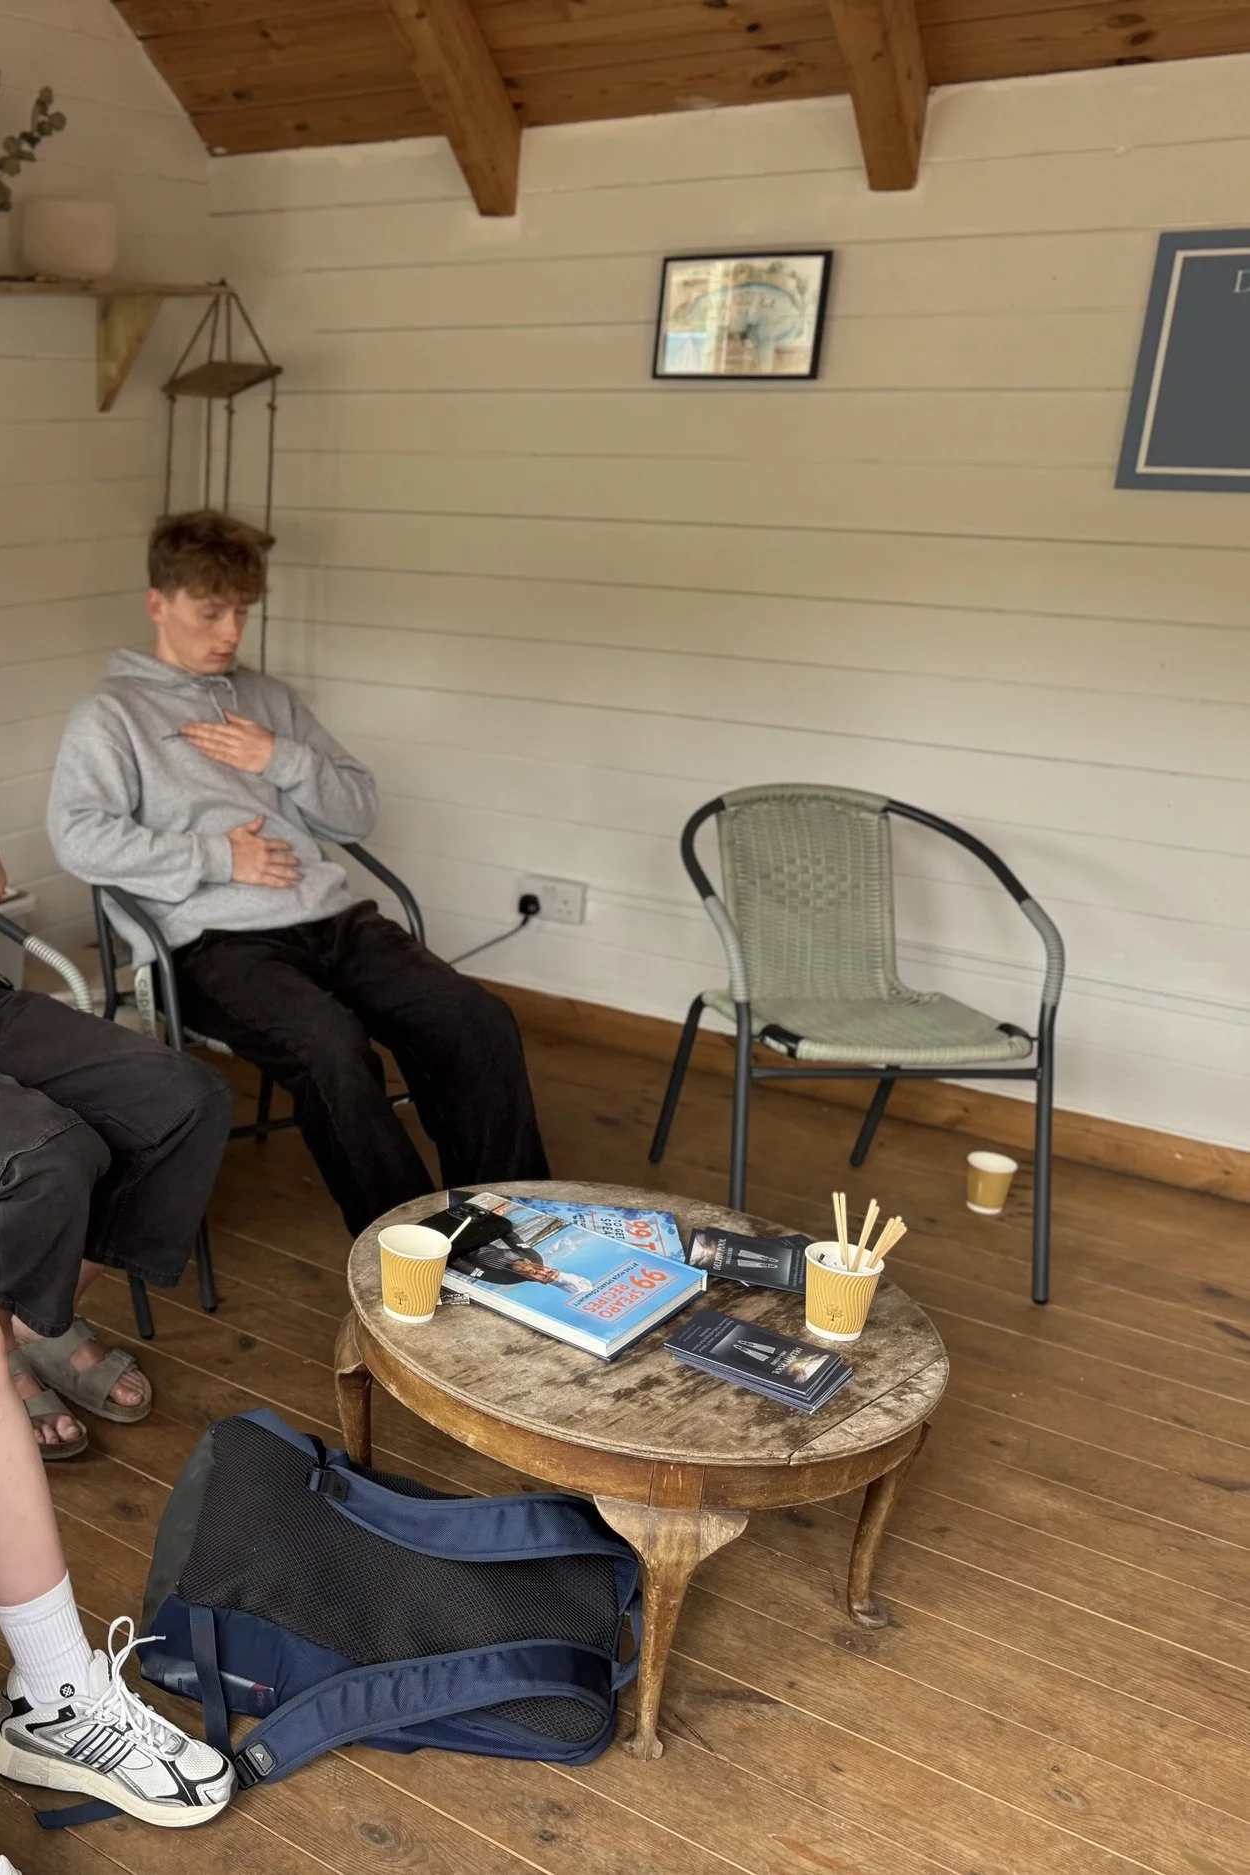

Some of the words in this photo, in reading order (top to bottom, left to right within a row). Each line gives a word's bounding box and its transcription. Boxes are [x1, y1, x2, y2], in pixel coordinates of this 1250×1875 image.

[613, 1219, 623, 1227] TO
[624, 1220, 652, 1239] 99
[614, 1228, 626, 1240] GET
[628, 1267, 668, 1291] 99
[581, 1282, 630, 1313] RECIPES
[598, 1288, 646, 1319] SPEARO
